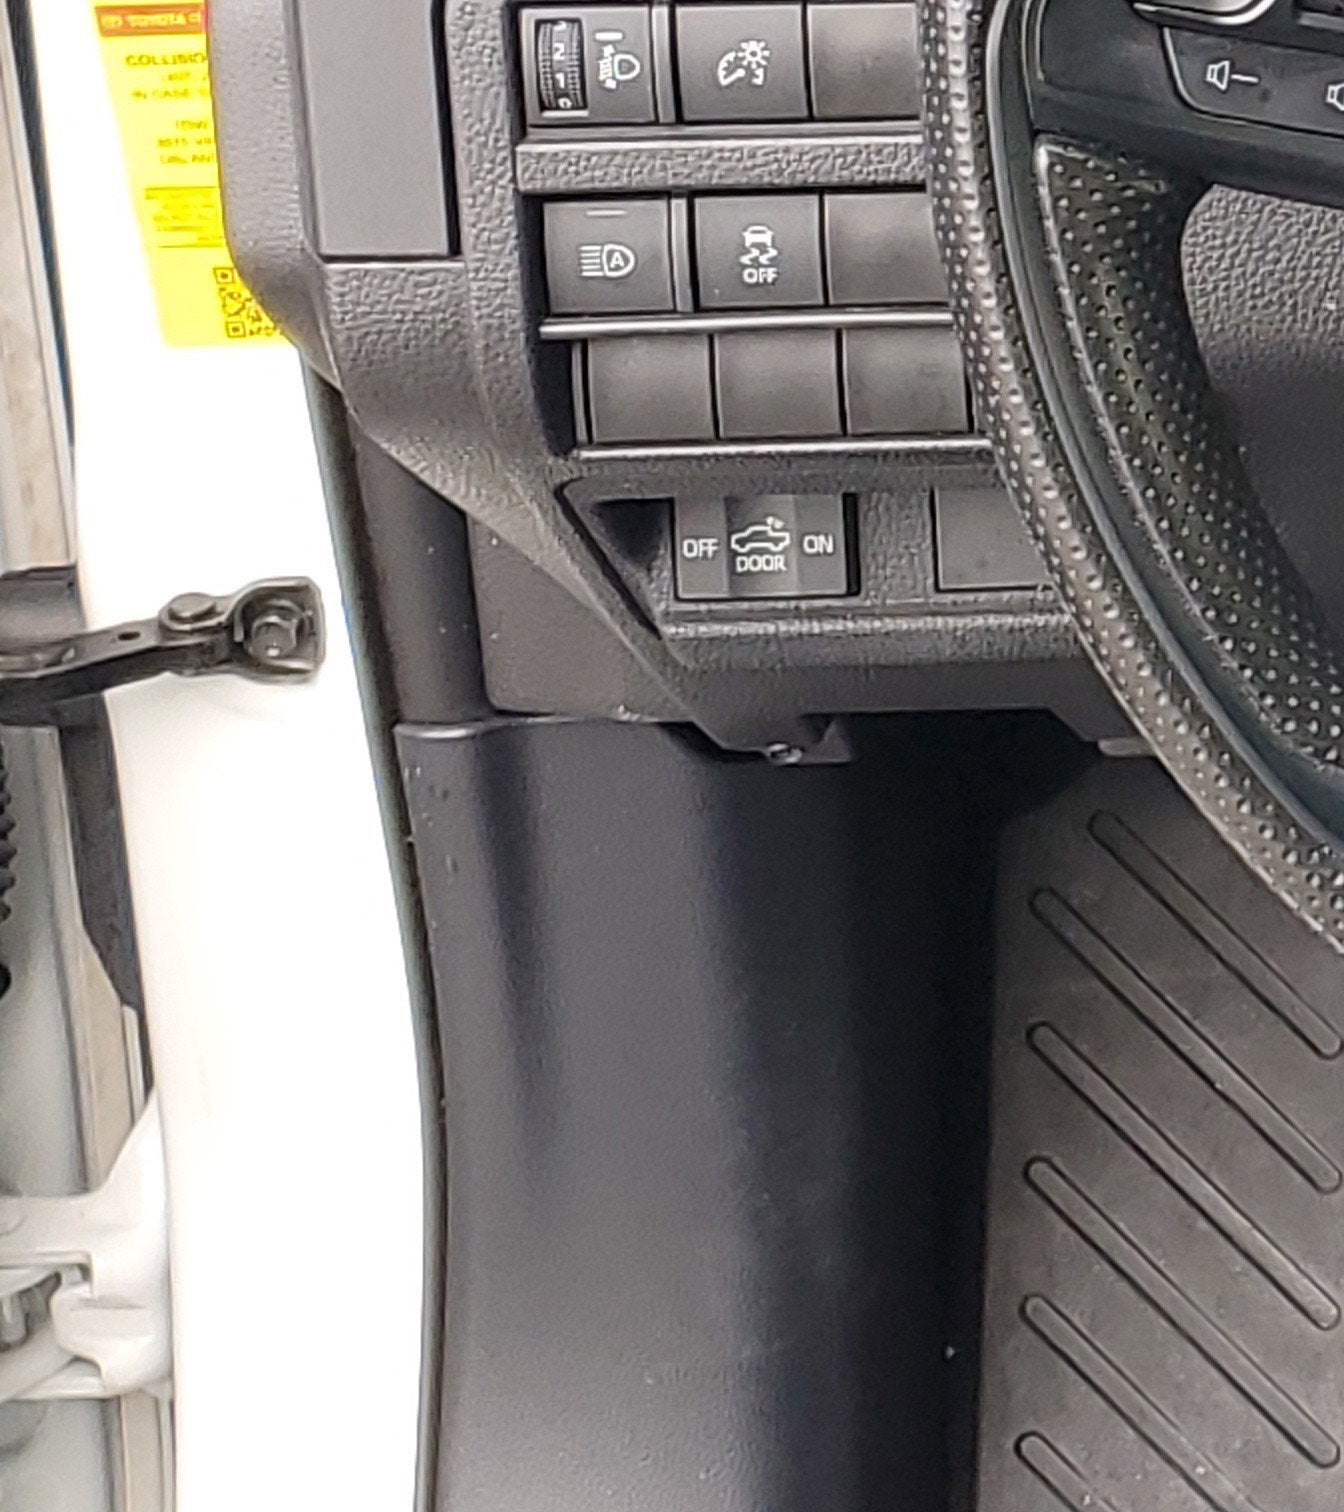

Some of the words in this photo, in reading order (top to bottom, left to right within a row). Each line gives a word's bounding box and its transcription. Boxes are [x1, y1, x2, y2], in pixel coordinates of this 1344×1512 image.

[553, 42, 566, 61] 2
[555, 72, 566, 89] 1
[743, 267, 779, 285] OFF
[682, 538, 719, 559] OFF
[802, 533, 834, 555] ON
[735, 553, 788, 573] DOOR
